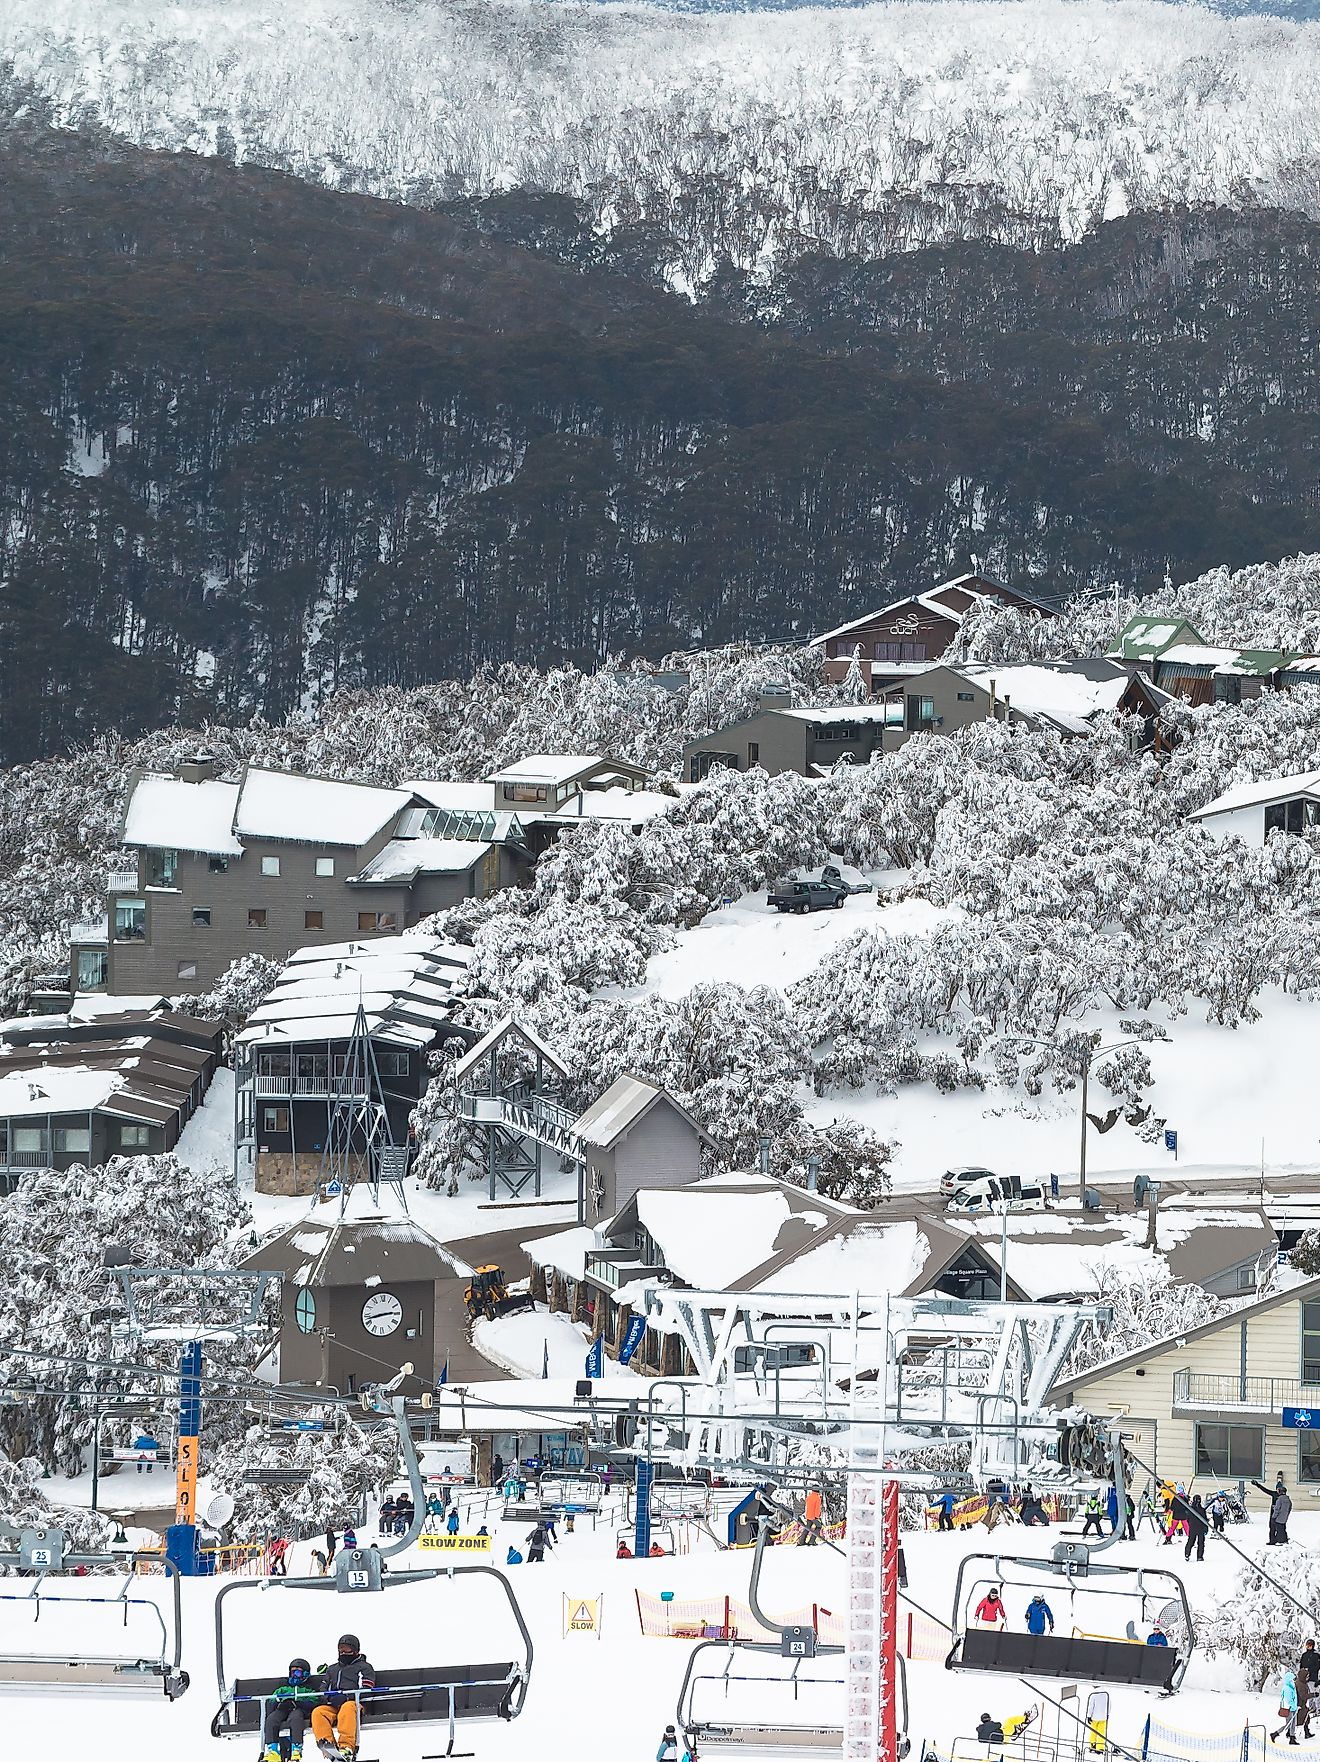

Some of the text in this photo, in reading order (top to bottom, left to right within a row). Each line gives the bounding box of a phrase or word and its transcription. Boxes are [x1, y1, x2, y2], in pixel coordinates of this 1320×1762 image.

[422, 1538, 488, 1549] SLOW ZONE
[36, 1551, 47, 1560] 25
[353, 1572, 364, 1582] 15
[571, 1622, 594, 1630] SLOW
[793, 1643, 802, 1651] 24
